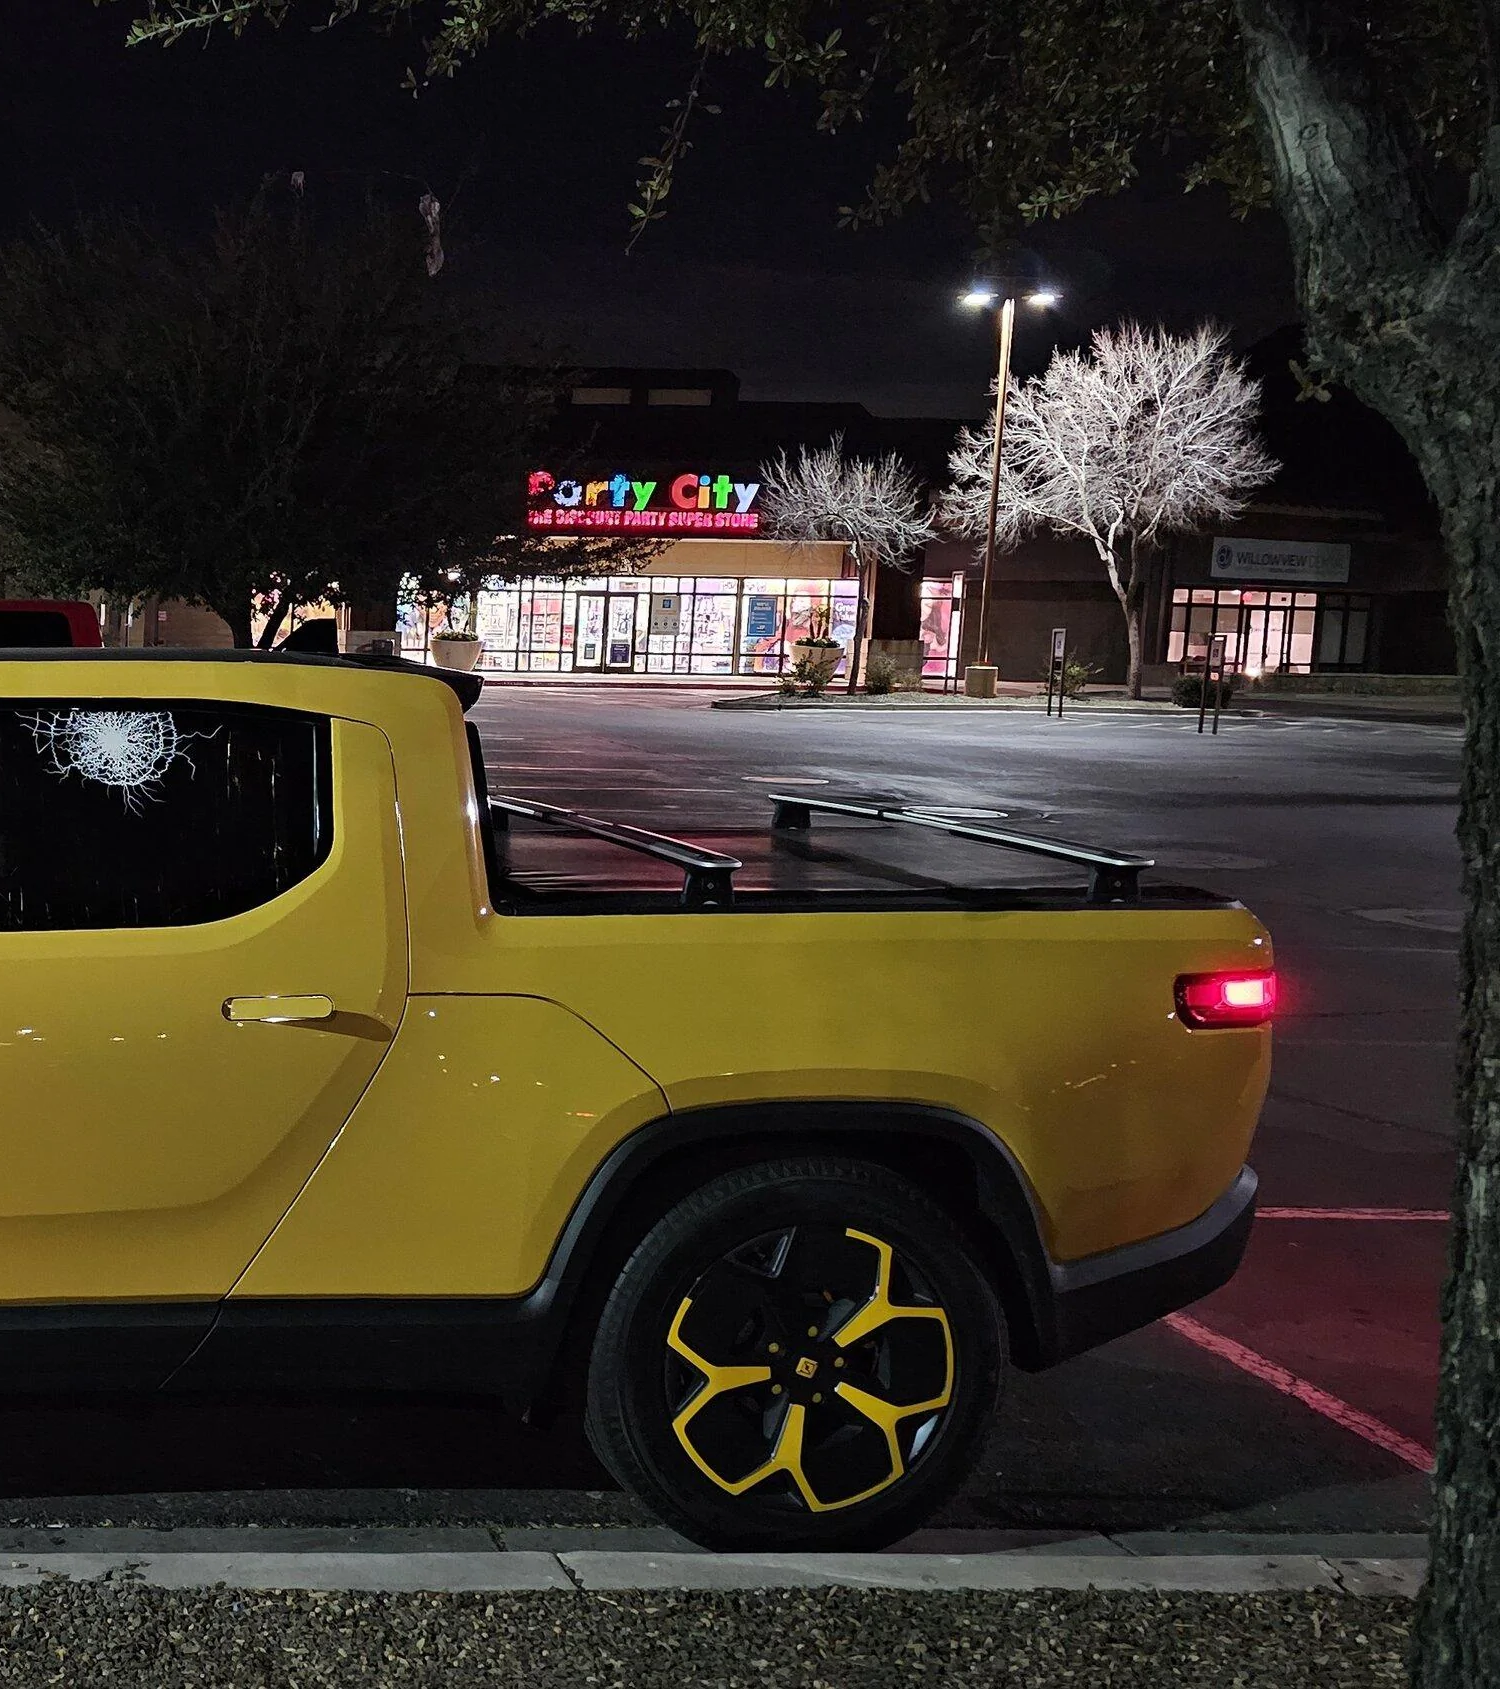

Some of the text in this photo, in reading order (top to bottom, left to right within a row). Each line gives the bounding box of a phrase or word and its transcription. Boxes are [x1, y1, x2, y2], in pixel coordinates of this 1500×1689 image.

[528, 471, 760, 513] Party City
[623, 510, 667, 527] PARTY
[715, 512, 759, 529] STORE
